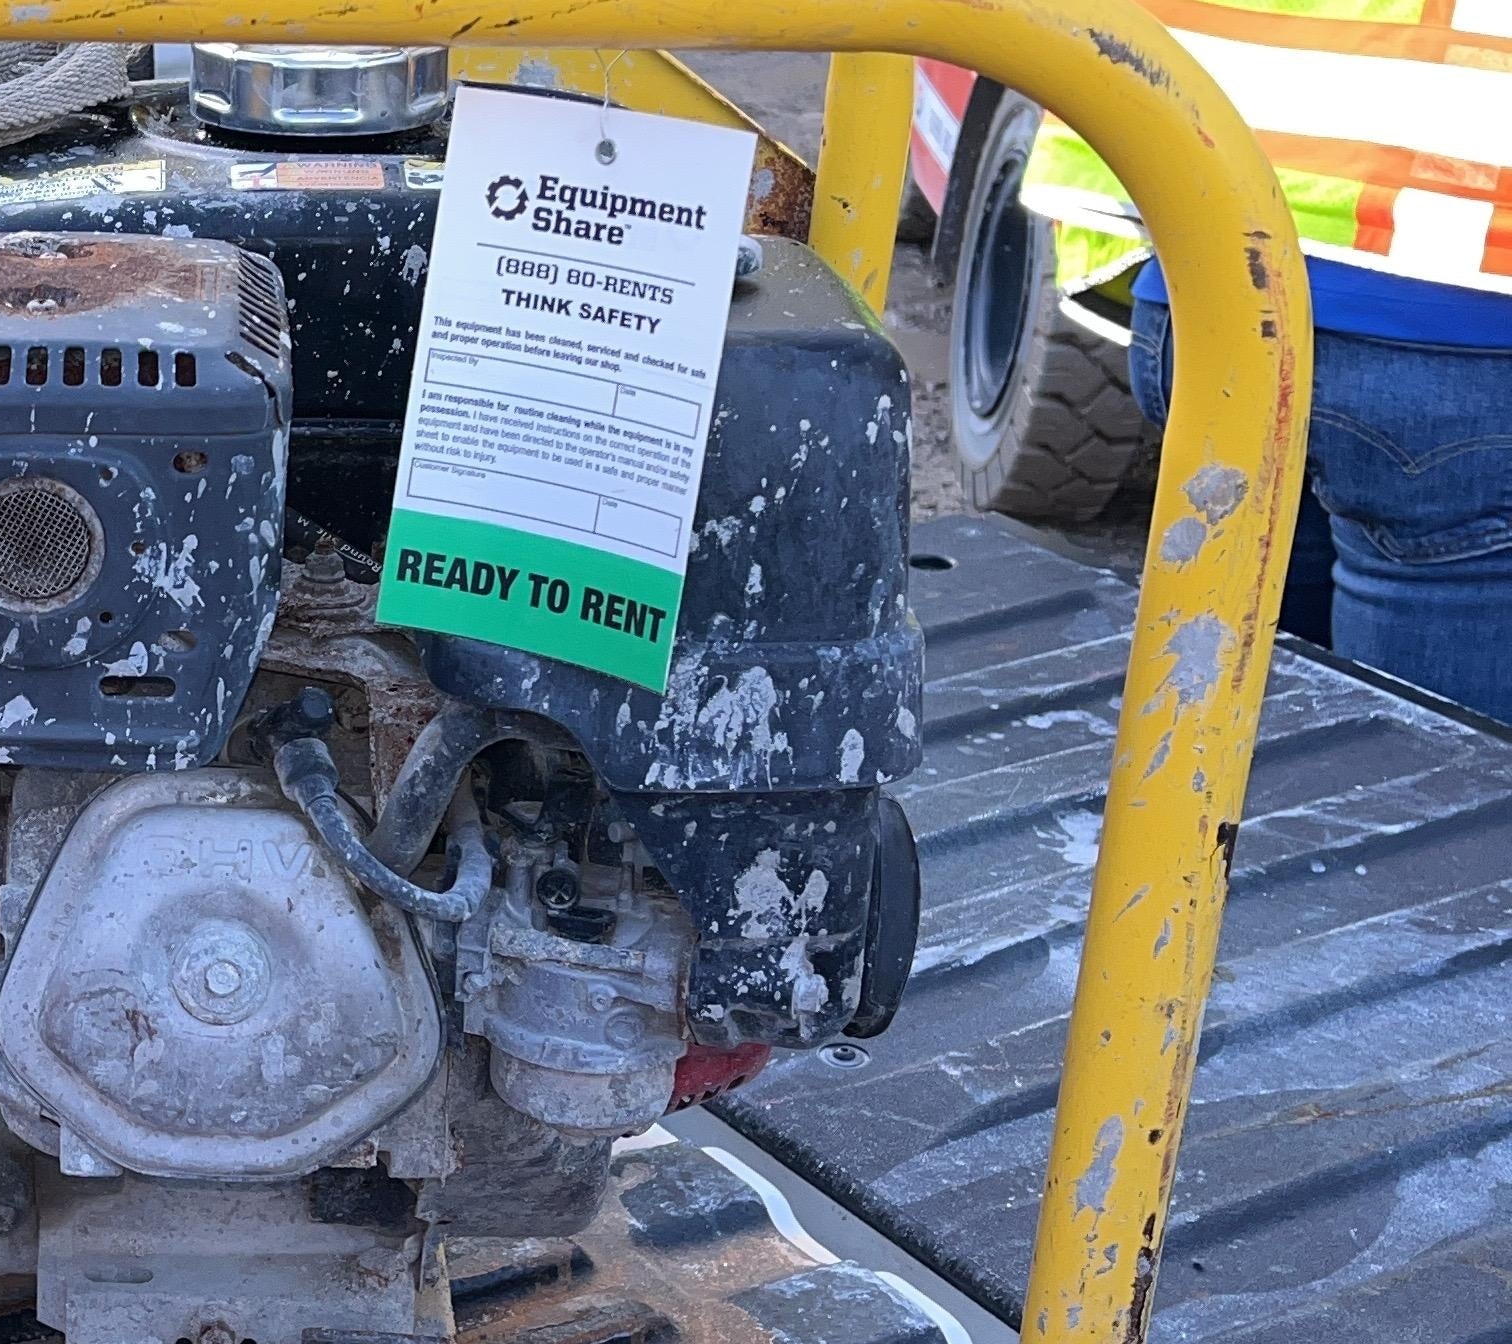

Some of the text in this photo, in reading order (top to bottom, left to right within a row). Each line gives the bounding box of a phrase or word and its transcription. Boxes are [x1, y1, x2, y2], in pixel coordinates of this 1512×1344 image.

[536, 174, 708, 230] Equipment
[496, 255, 675, 305] (888) 80-RENTS
[501, 288, 662, 334] THINK SAFETY
[431, 330, 622, 373] and proper operation before leaving our shop.
[433, 315, 706, 379] This equipment has been cleaned, serviced and checked for safe
[414, 442, 497, 465] without risk to injury.
[417, 416, 462, 430] equipment
[463, 423, 479, 433] and
[479, 425, 499, 437] have
[500, 430, 521, 441] been
[522, 434, 554, 447] directed
[555, 440, 563, 449] to
[565, 442, 577, 453] the
[617, 456, 645, 469] manual
[669, 469, 690, 484] safety
[419, 404, 471, 419] possession.
[478, 411, 498, 423] have
[500, 416, 535, 430] received
[536, 423, 581, 440] instructions
[582, 434, 593, 443] on
[595, 435, 607, 446] the
[609, 439, 636, 453] correct
[637, 447, 670, 462] operation
[671, 455, 680, 465] of
[680, 458, 691, 469] the
[428, 391, 442, 401] am
[444, 393, 494, 409] responsible
[497, 401, 510, 411] for
[514, 406, 544, 419] routine
[546, 411, 581, 428] cleaning
[584, 420, 605, 432] while
[608, 424, 621, 435] the
[623, 430, 663, 447] equipment
[665, 439, 672, 449] is
[673, 441, 681, 451] in
[682, 446, 694, 457] my
[416, 429, 439, 440] sheet
[441, 432, 450, 442] to
[452, 435, 480, 447] enable
[481, 439, 495, 449] the
[497, 442, 539, 458] equipment
[541, 450, 550, 460] to
[551, 452, 562, 462] be
[564, 456, 583, 468] used
[585, 461, 593, 469] in
[602, 465, 618, 477] safe
[620, 470, 635, 480] and
[636, 474, 660, 487] proper
[661, 482, 688, 496] manner
[396, 547, 667, 644] READY TO RENT
